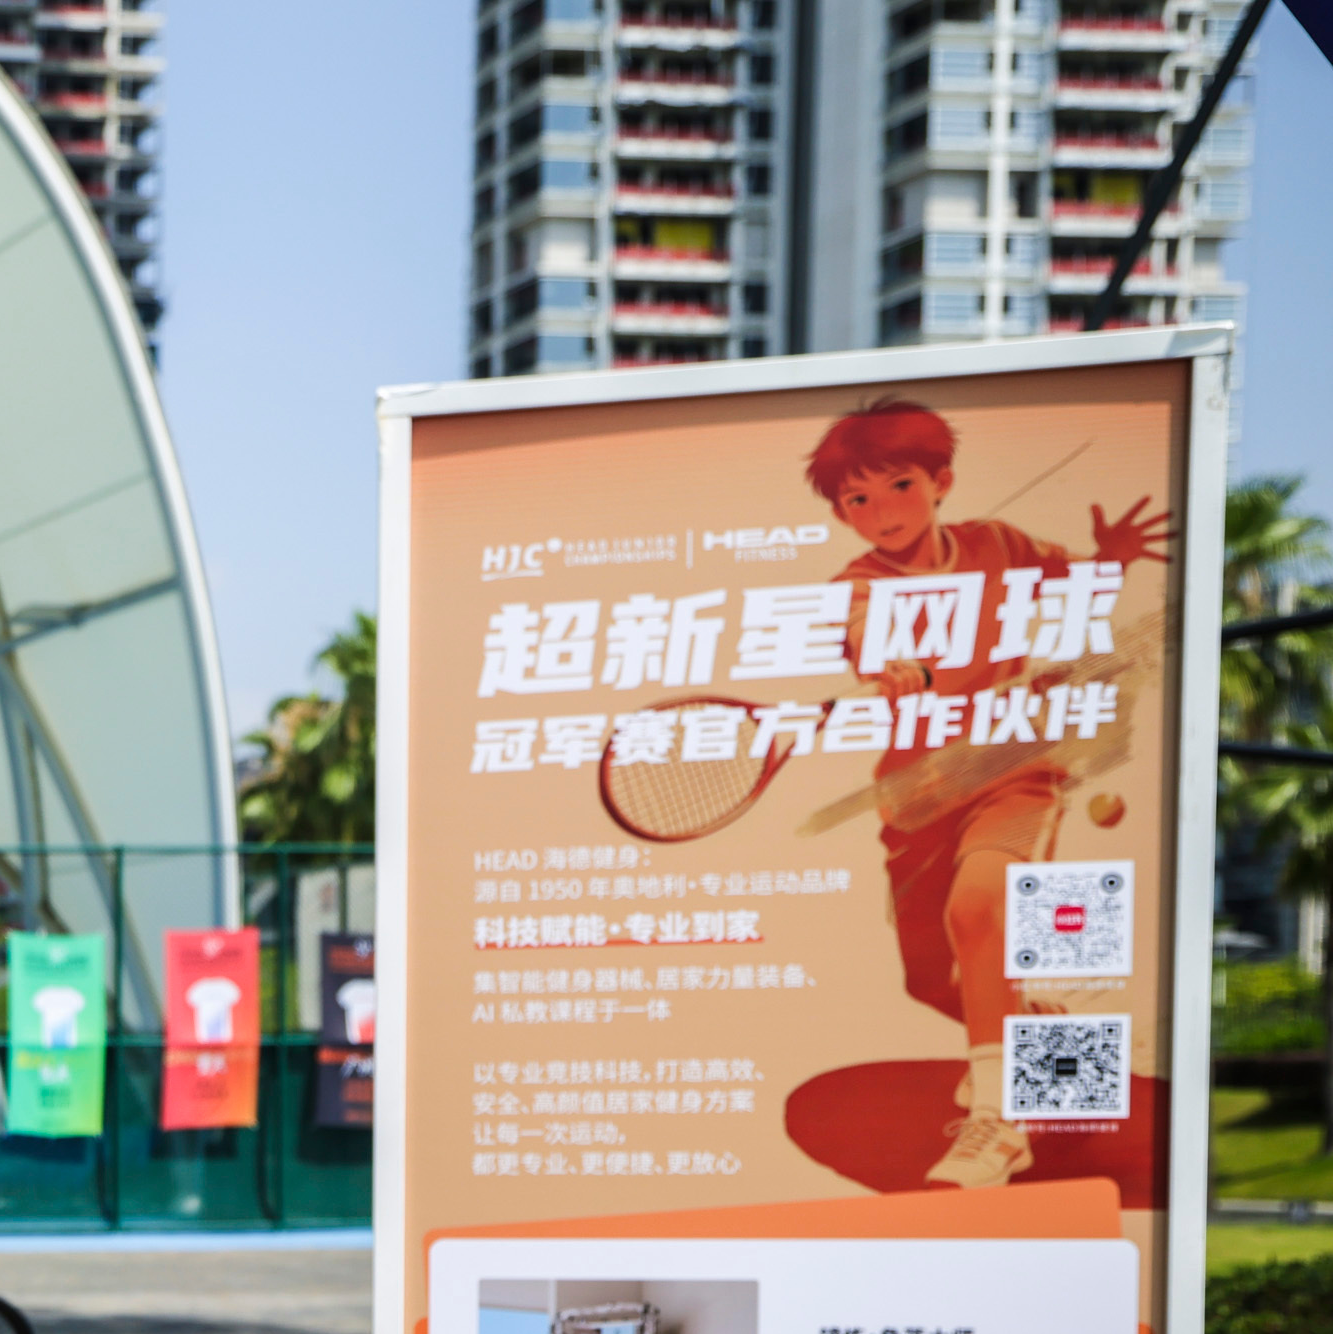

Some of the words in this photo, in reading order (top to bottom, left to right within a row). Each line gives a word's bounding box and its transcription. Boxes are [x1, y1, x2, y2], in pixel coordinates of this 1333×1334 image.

[702, 524, 830, 551] HEAD
[481, 542, 544, 573] HJC
[477, 561, 1123, 698] 超新星网球
[470, 683, 1119, 774] 冠军赛官方合作伙伴
[474, 850, 538, 872] HEAD
[475, 880, 522, 904] 源自
[529, 878, 583, 902] 1950
[474, 910, 760, 947] 科技赋能·专业到家
[472, 1003, 495, 1023] AI
[499, 998, 672, 1022] 私教课程于一体
